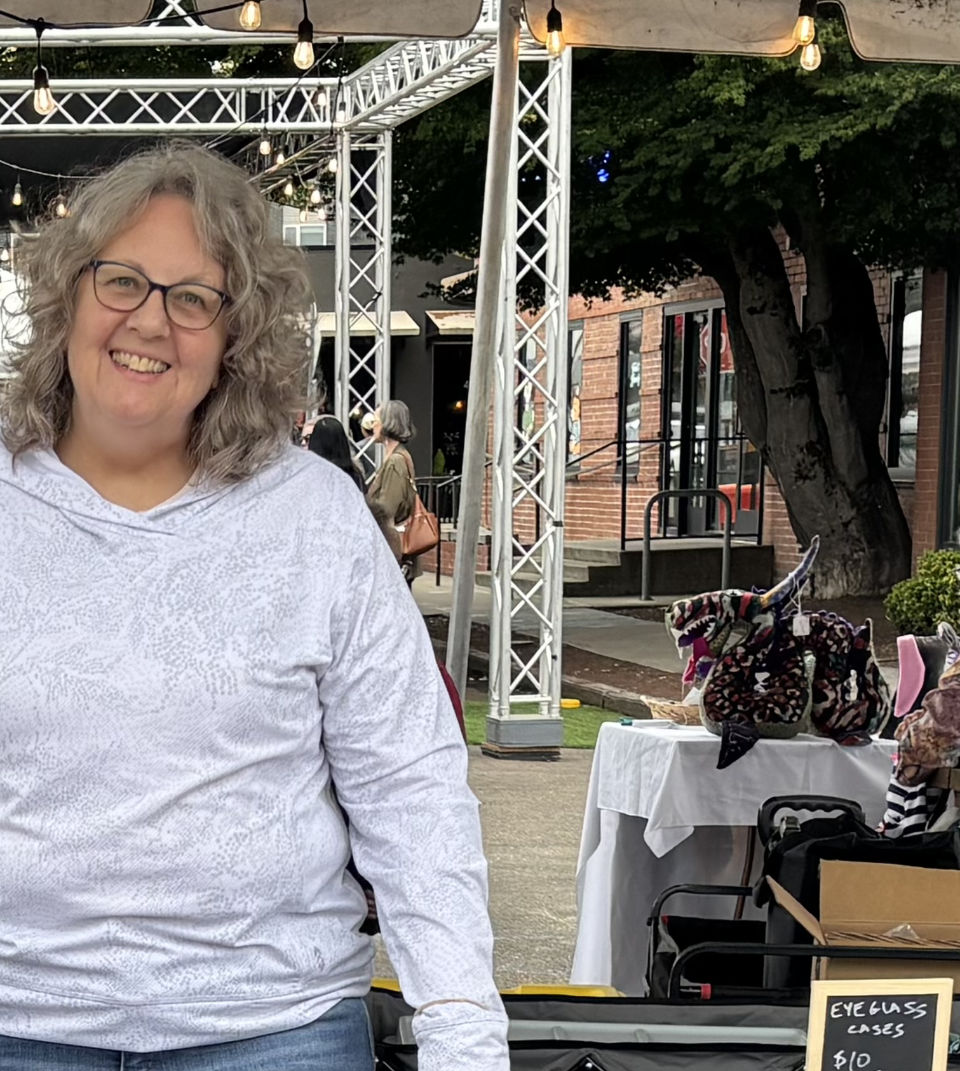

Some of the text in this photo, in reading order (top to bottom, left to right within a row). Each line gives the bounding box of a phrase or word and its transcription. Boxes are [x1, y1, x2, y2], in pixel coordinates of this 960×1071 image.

[830, 1001, 928, 1019] EYEGLASS
[847, 1023, 905, 1038] CASES
[833, 1050, 871, 1071] $10
